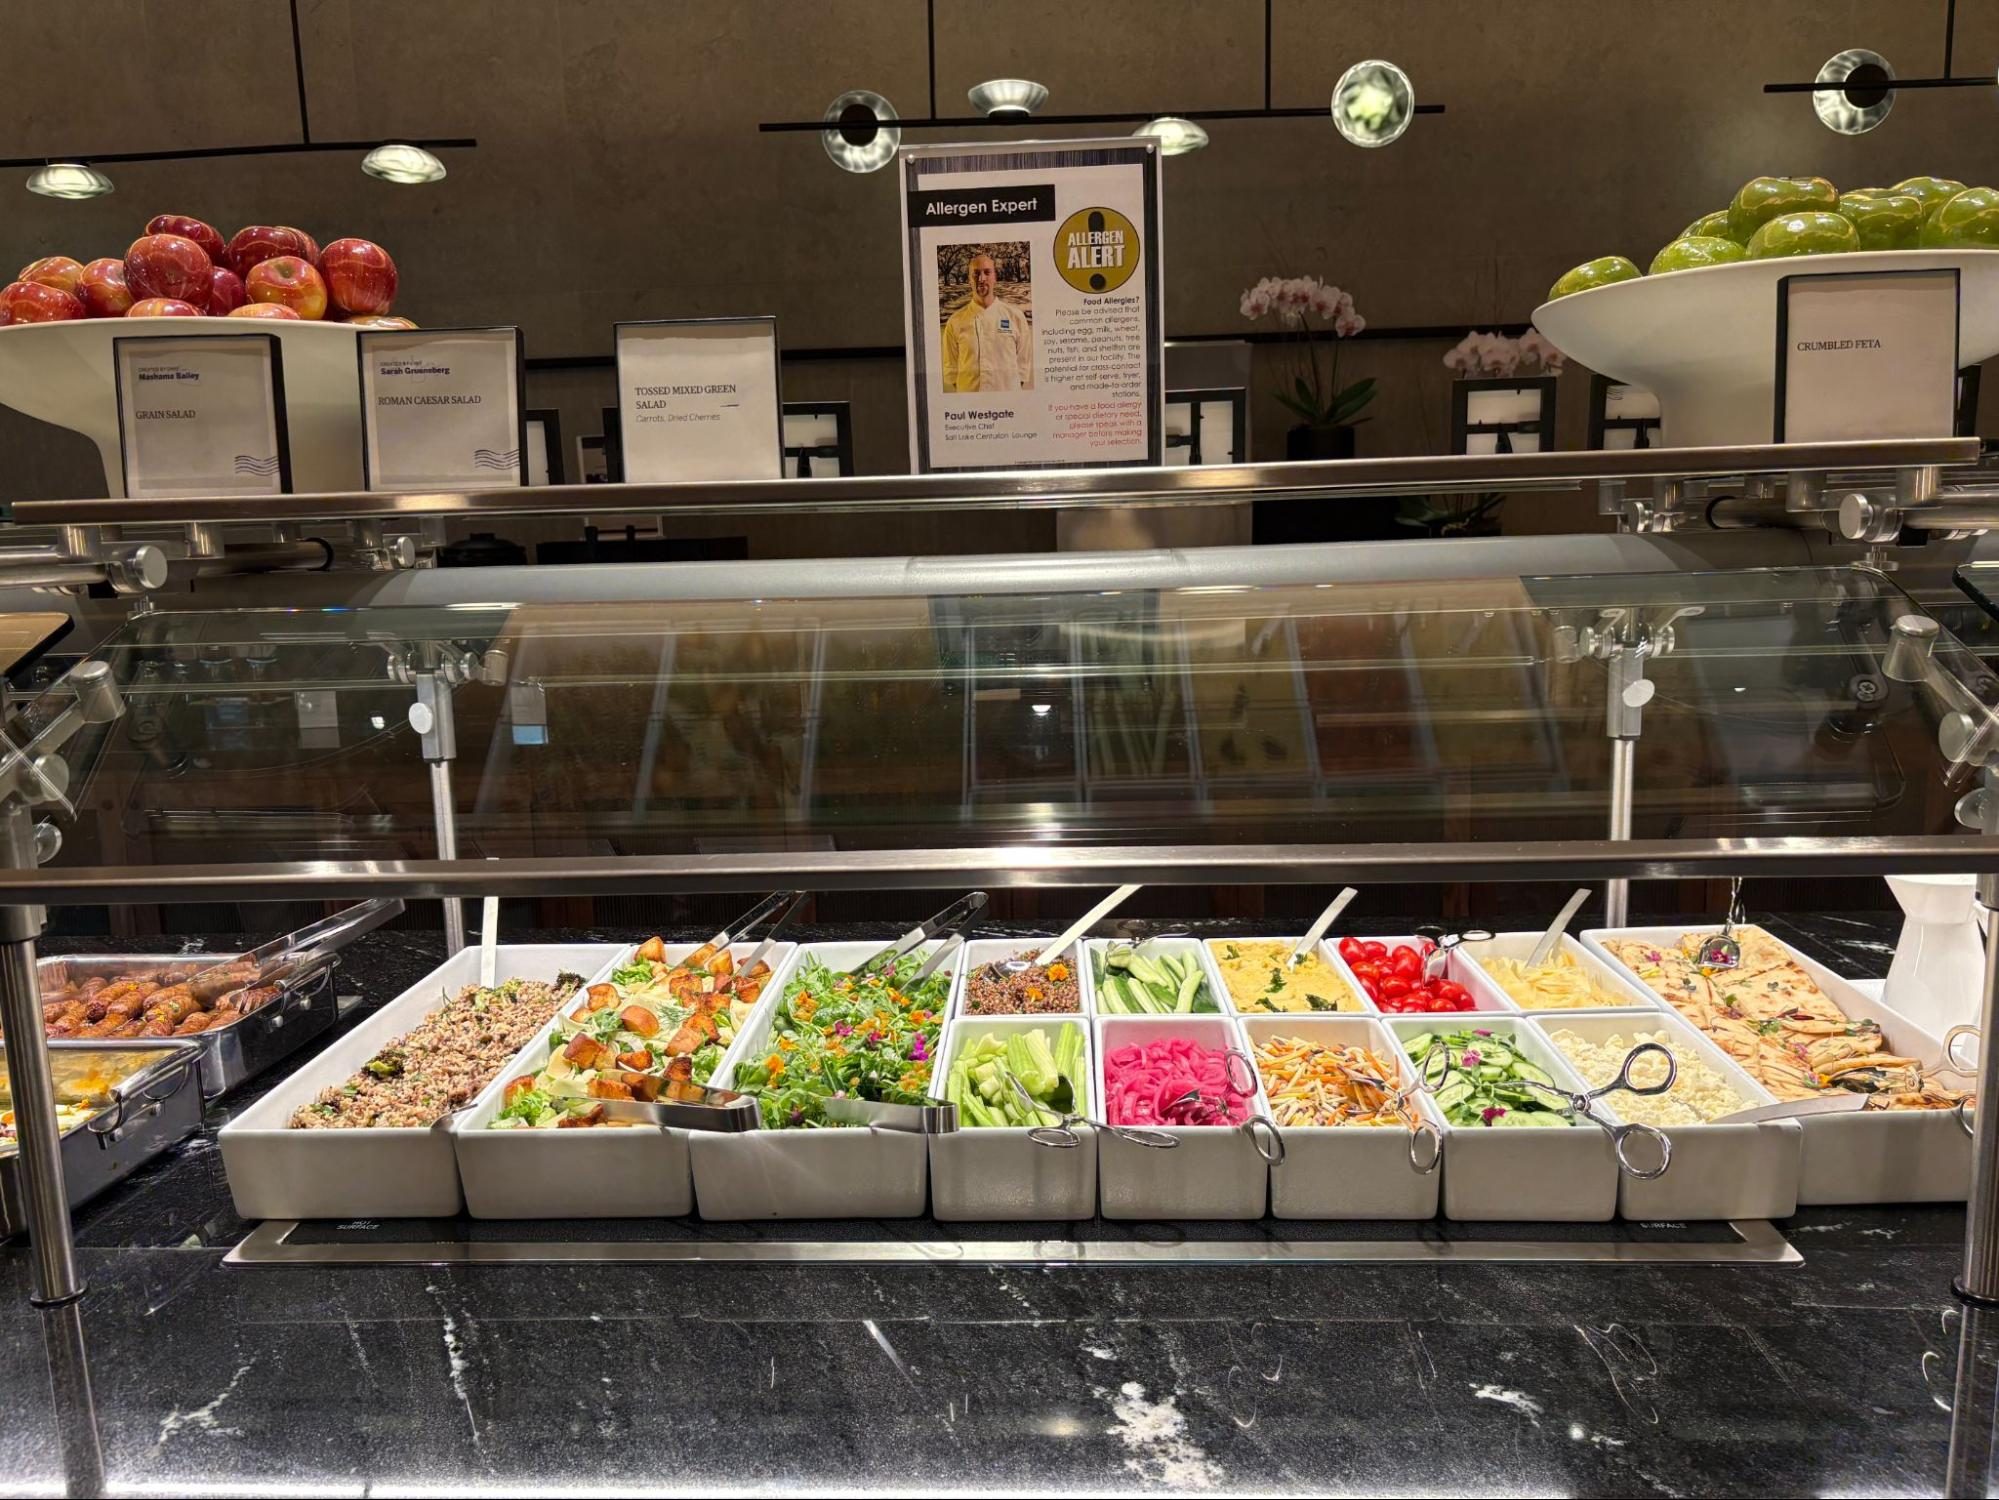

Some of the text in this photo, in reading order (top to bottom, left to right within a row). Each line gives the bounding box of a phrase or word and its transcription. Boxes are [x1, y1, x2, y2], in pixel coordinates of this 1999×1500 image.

[926, 198, 1038, 217] Allergen Expert
[1068, 230, 1124, 246] ALLERGEN
[1067, 244, 1125, 269] ALERT
[1104, 296, 1140, 305] Allergies?
[1042, 328, 1076, 336] including
[1797, 339, 1881, 351] CRUMBLED FETA
[1049, 356, 1076, 364] present
[1100, 353, 1125, 361] facility.
[381, 367, 403, 375] Sarah
[1045, 365, 1077, 373] potential
[1091, 363, 1140, 371] cross-contact
[175, 372, 199, 380] Bailey
[1050, 375, 1074, 383] higher
[634, 384, 736, 396] TOSSED MIXED GREEN
[378, 395, 482, 405] ROMAN CAESAR SALAD
[636, 400, 667, 409] SALAD
[1117, 401, 1142, 409] allergy
[136, 409, 196, 419] GRAIN SALAD
[636, 415, 665, 423] Carrots,
[689, 413, 720, 421] Cherries
[945, 410, 1014, 421] Paul Westgate
[1065, 413, 1090, 421] special
[1092, 411, 1118, 419] dietary
[1070, 422, 1094, 430] please
[1011, 432, 1038, 440] Lounge
[1088, 430, 1113, 438] before
[1114, 429, 1142, 437] making
[1090, 440, 1105, 448] your
